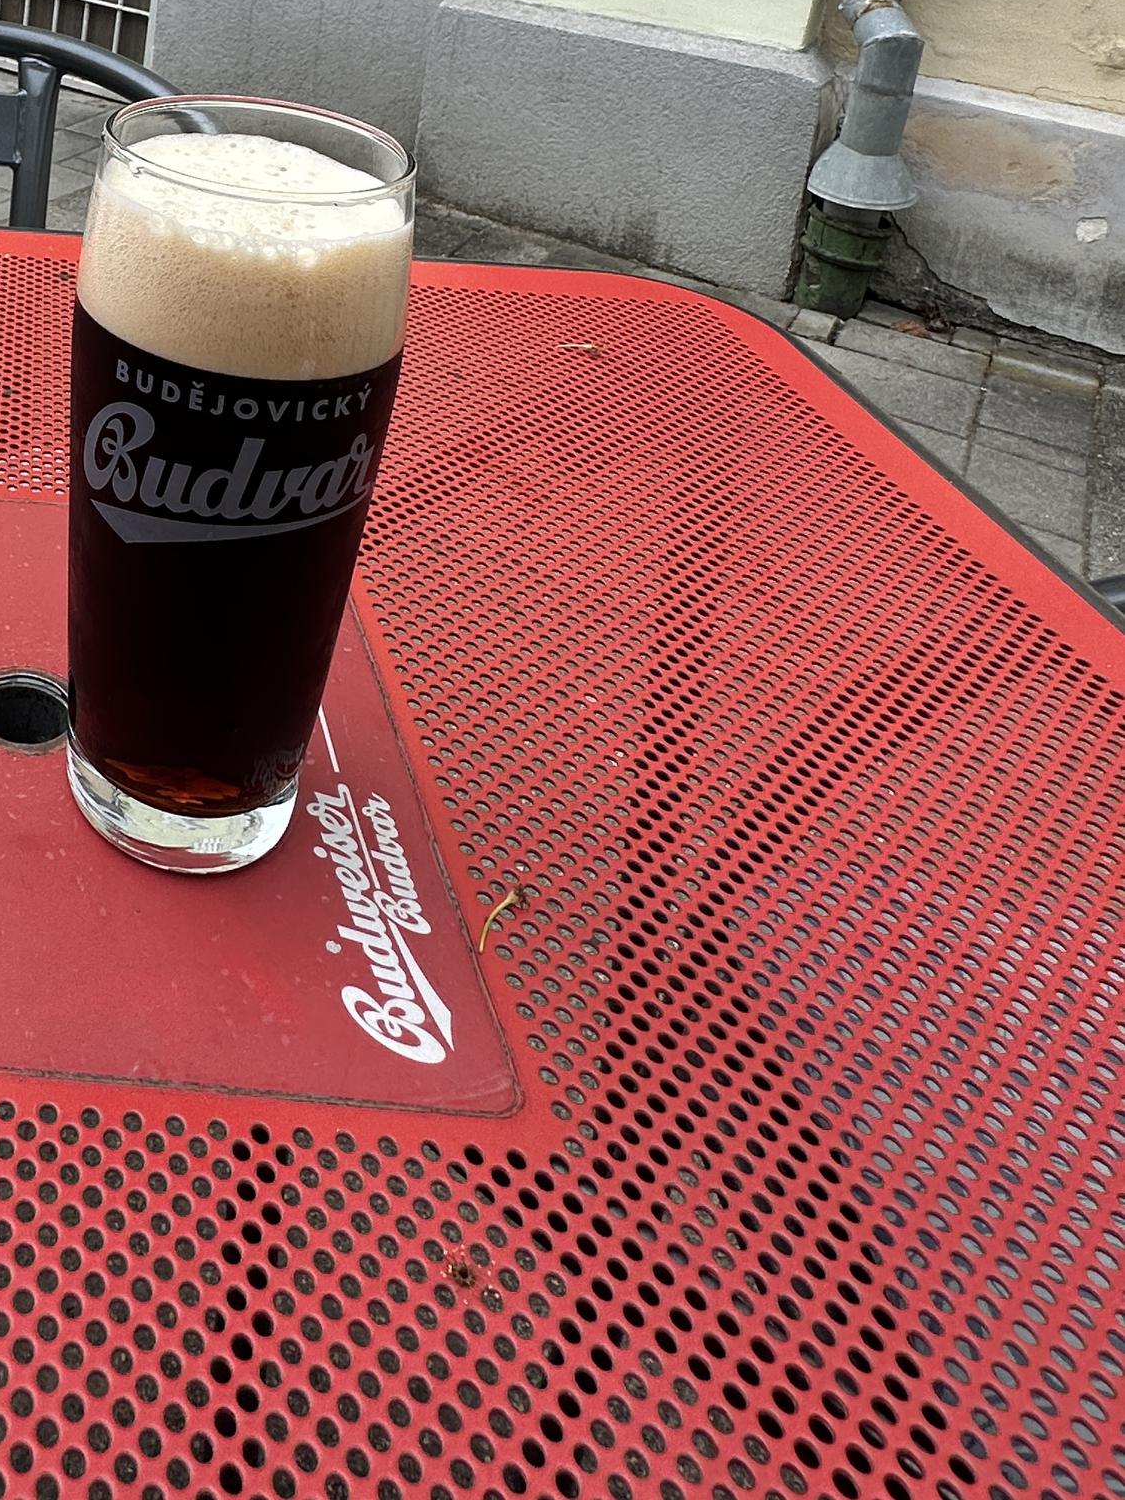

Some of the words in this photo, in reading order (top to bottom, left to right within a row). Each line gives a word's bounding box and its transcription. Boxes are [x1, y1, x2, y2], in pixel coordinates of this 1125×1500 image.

[116, 359, 372, 422] BUDĚJOVICKÝ
[84, 401, 375, 519] Budvar
[306, 784, 446, 1064] Budweiser
[362, 791, 432, 935] Budvar
